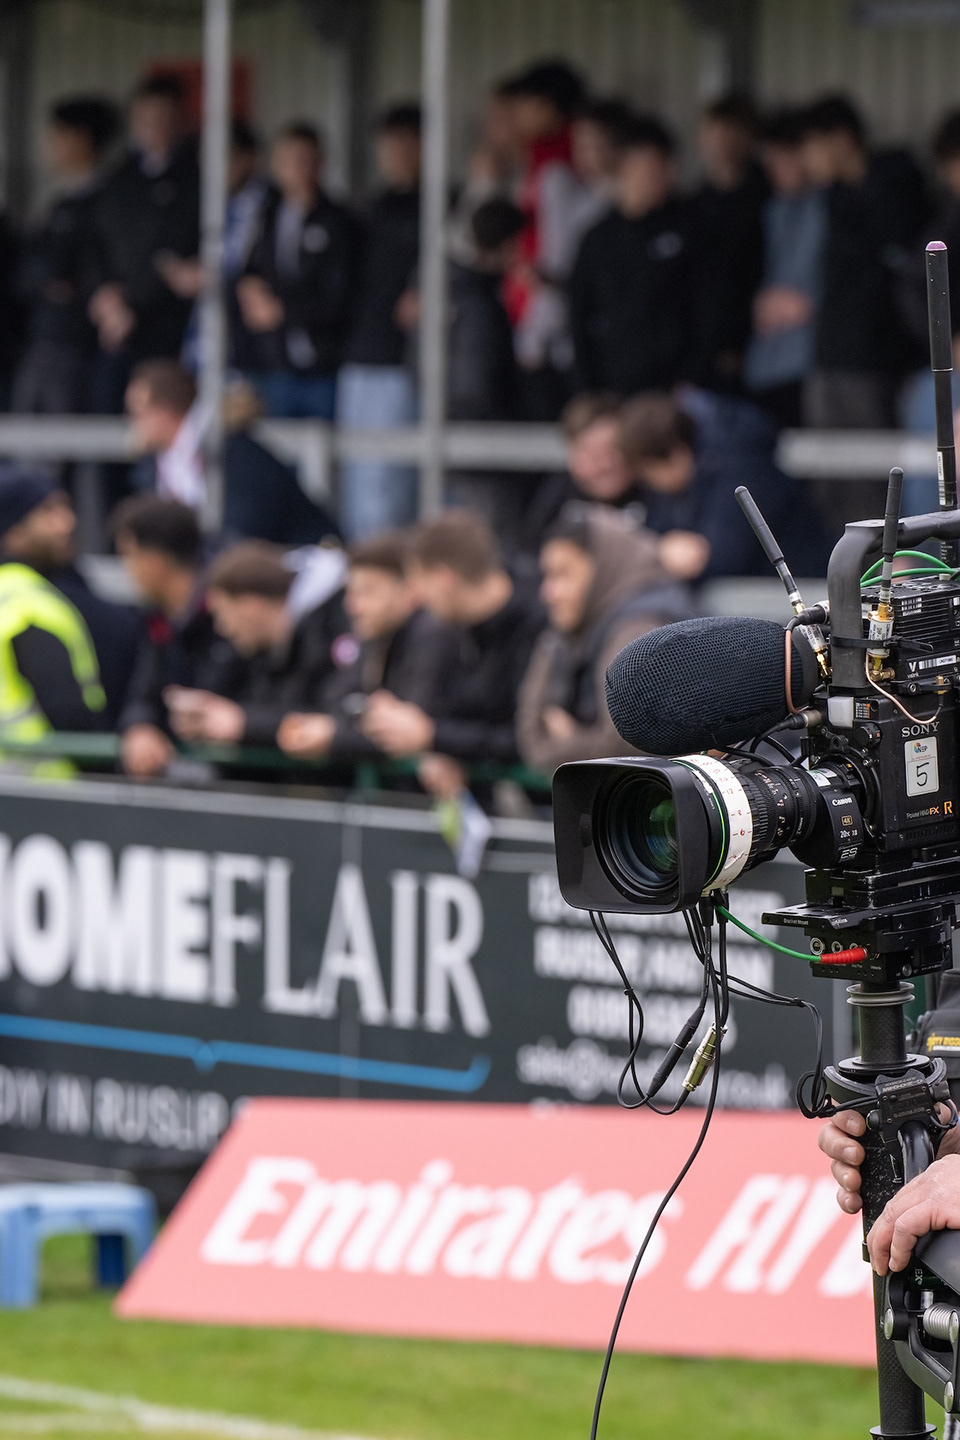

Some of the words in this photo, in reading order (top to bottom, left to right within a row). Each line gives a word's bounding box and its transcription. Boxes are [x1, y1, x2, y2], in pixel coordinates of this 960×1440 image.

[901, 721, 940, 738] SONY
[916, 762, 930, 787] 5
[832, 797, 853, 807] Canon
[943, 800, 953, 815] R
[0, 832, 492, 1038] OMEFLAIR
[199, 1155, 686, 1286] Emirates
